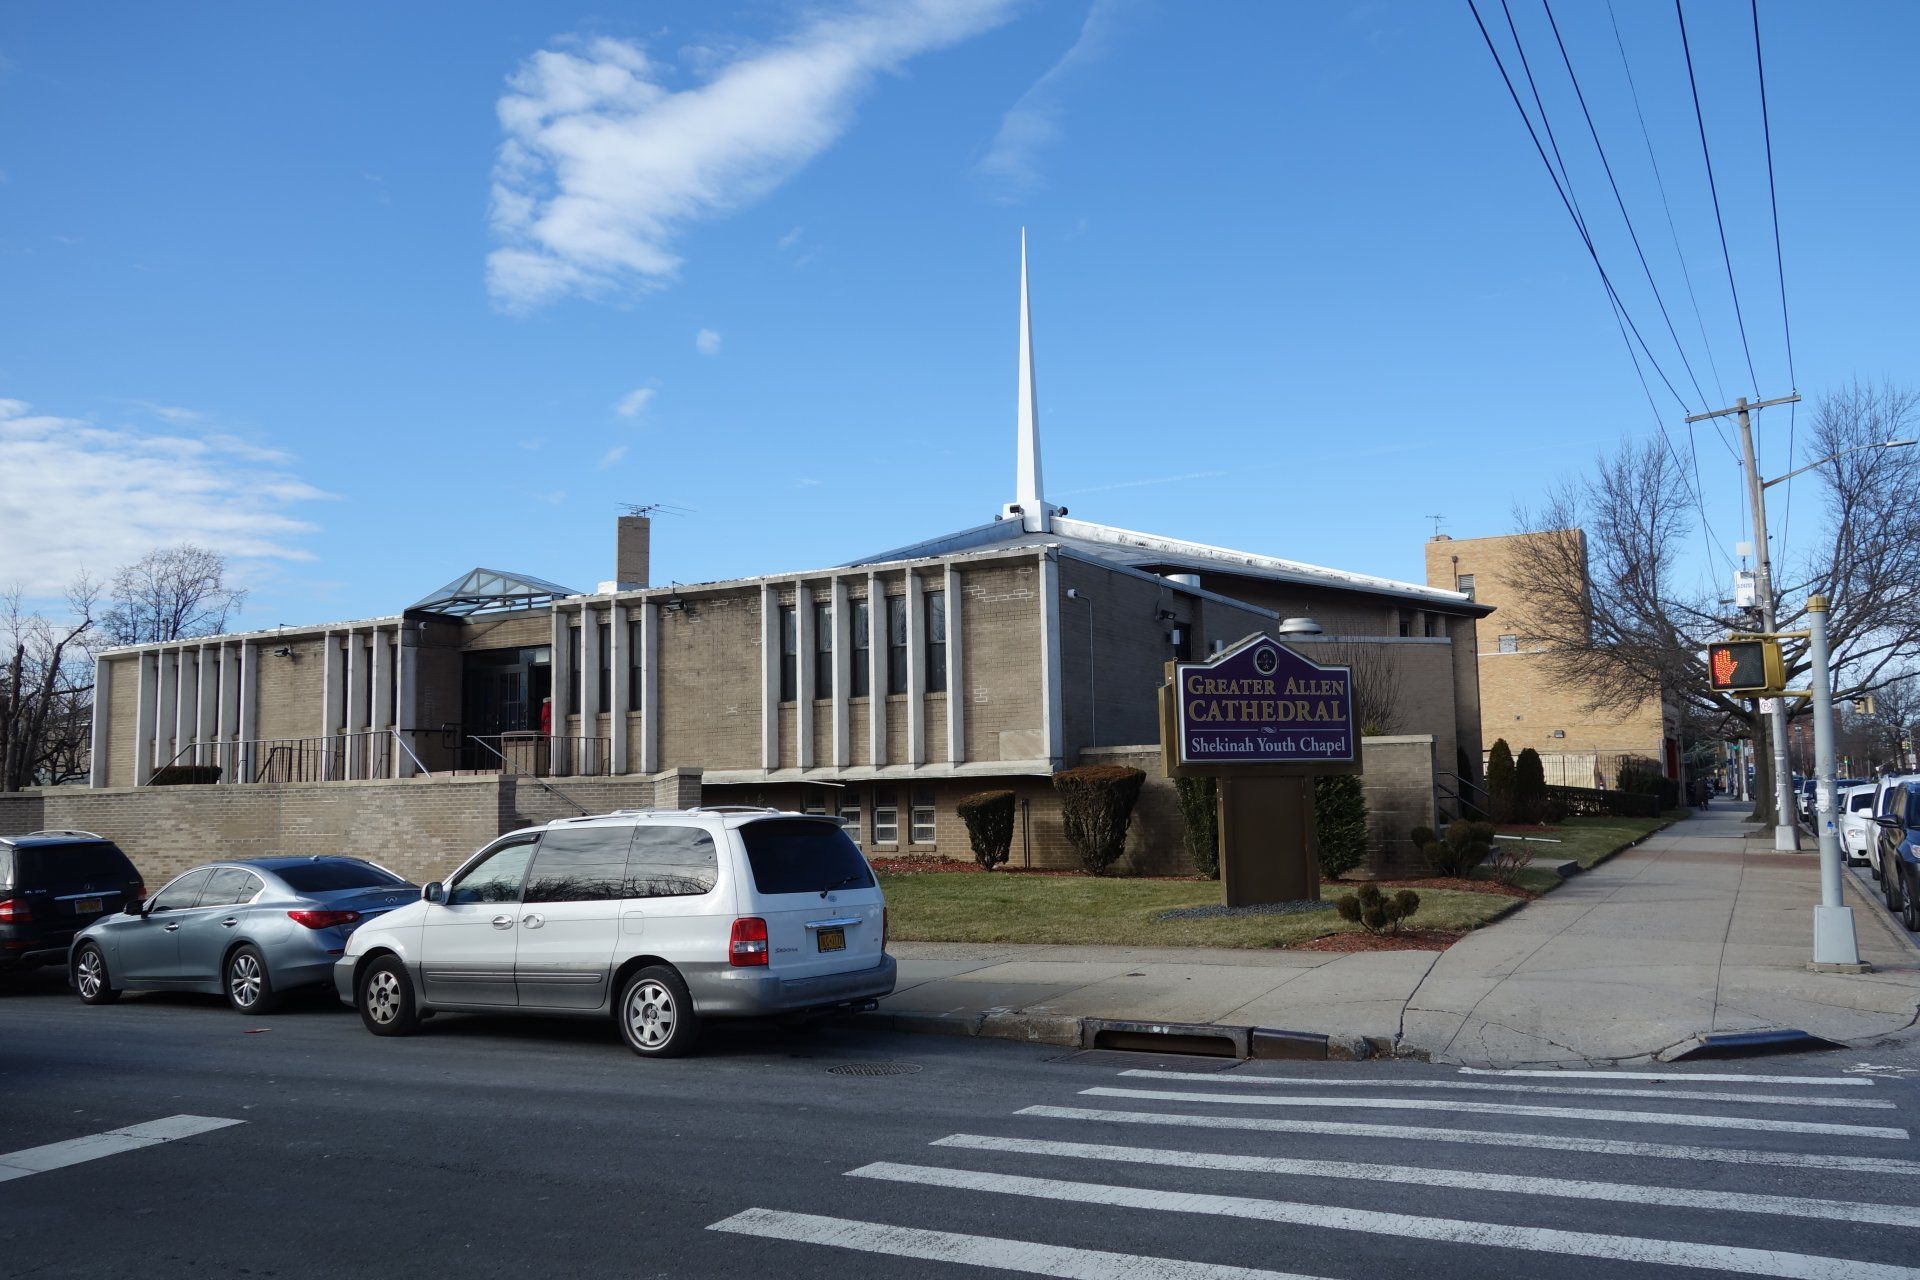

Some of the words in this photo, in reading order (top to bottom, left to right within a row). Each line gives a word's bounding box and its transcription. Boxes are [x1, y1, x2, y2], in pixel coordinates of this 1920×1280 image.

[1188, 700, 1346, 722] CATHEDRAL
[1192, 737, 1254, 752] Shekinah
[1257, 737, 1296, 752] Youth
[1300, 736, 1346, 756] Chapel
